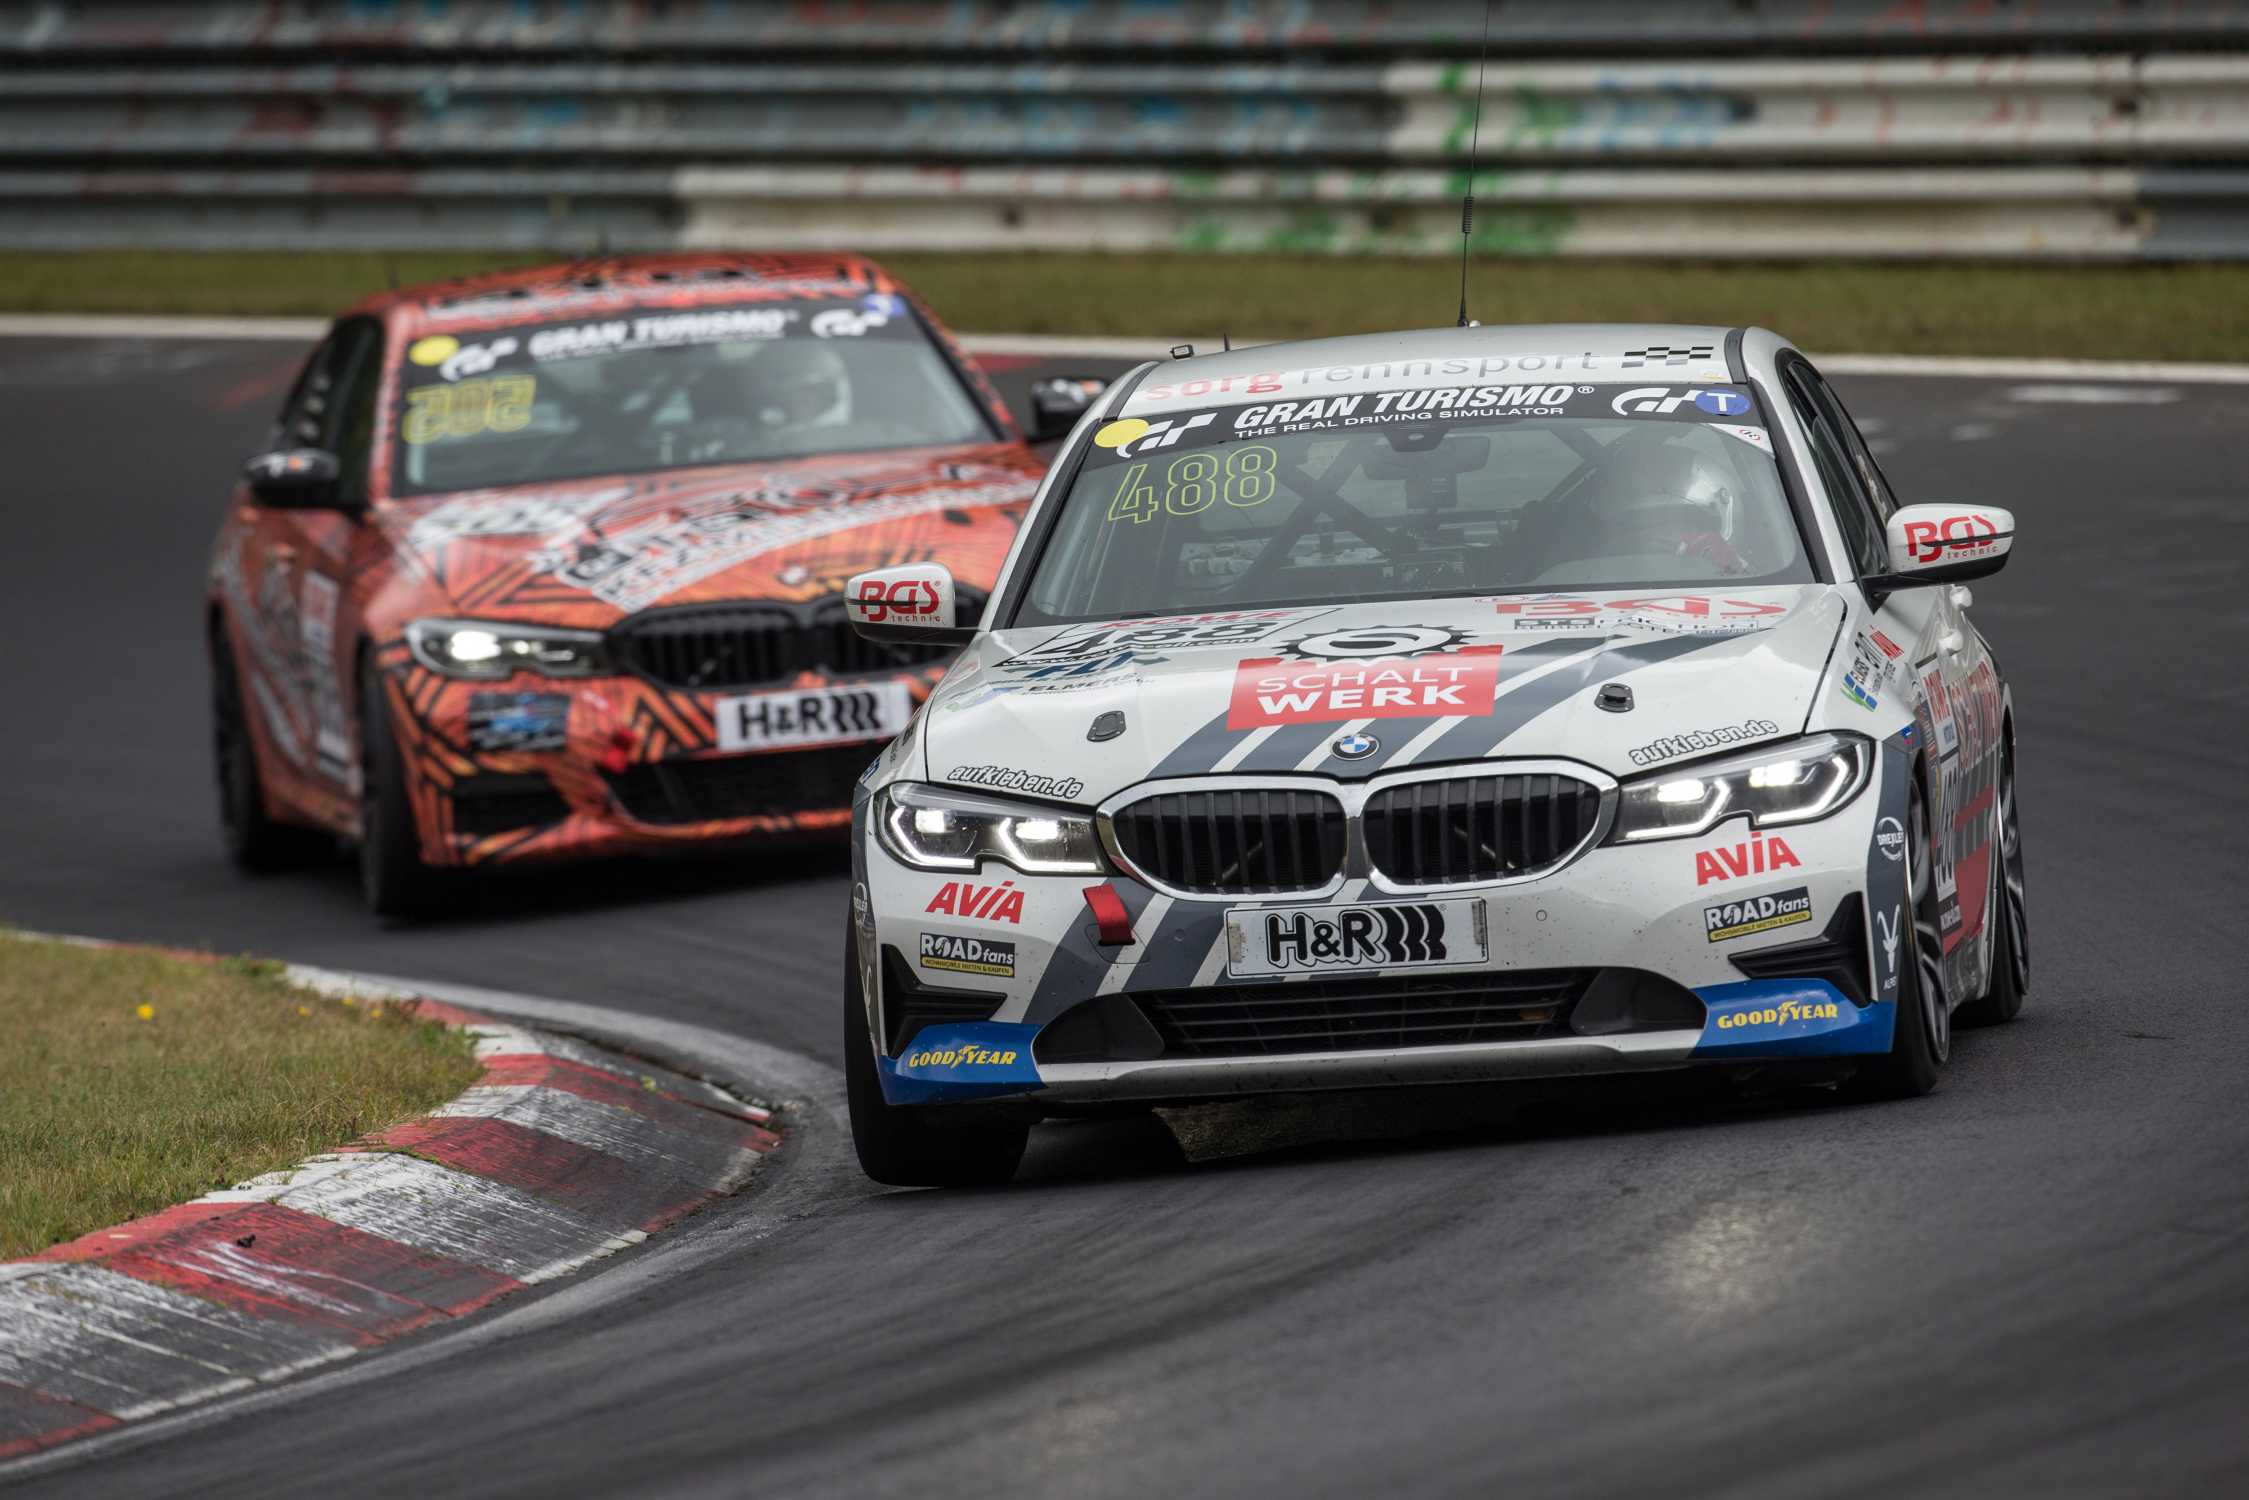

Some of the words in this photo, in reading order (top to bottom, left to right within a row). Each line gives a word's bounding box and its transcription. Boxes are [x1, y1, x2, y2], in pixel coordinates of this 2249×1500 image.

[528, 321, 628, 357] GRAN
[1144, 371, 1282, 400] sorg
[1301, 352, 1599, 385] rennsport
[1233, 395, 1364, 429] GRAN
[1707, 392, 1737, 412] T
[1235, 426, 1276, 439] THE
[1283, 419, 1339, 433] REAL
[1344, 412, 1432, 425] DRIVING
[1439, 407, 1564, 419] SIMULATOR
[1107, 445, 1277, 524] 488
[1947, 545, 1998, 559] technic
[1030, 621, 1279, 656] 488
[1256, 667, 1473, 693] SCHALT
[1256, 684, 1467, 715] WERK
[1629, 718, 1779, 767] aufkleben.de
[948, 765, 1084, 799] aufkleben.de
[1266, 909, 1385, 967] H&R
[1717, 1001, 1838, 1029] GOODYEAR
[908, 1045, 1017, 1069] GOODYEAR
